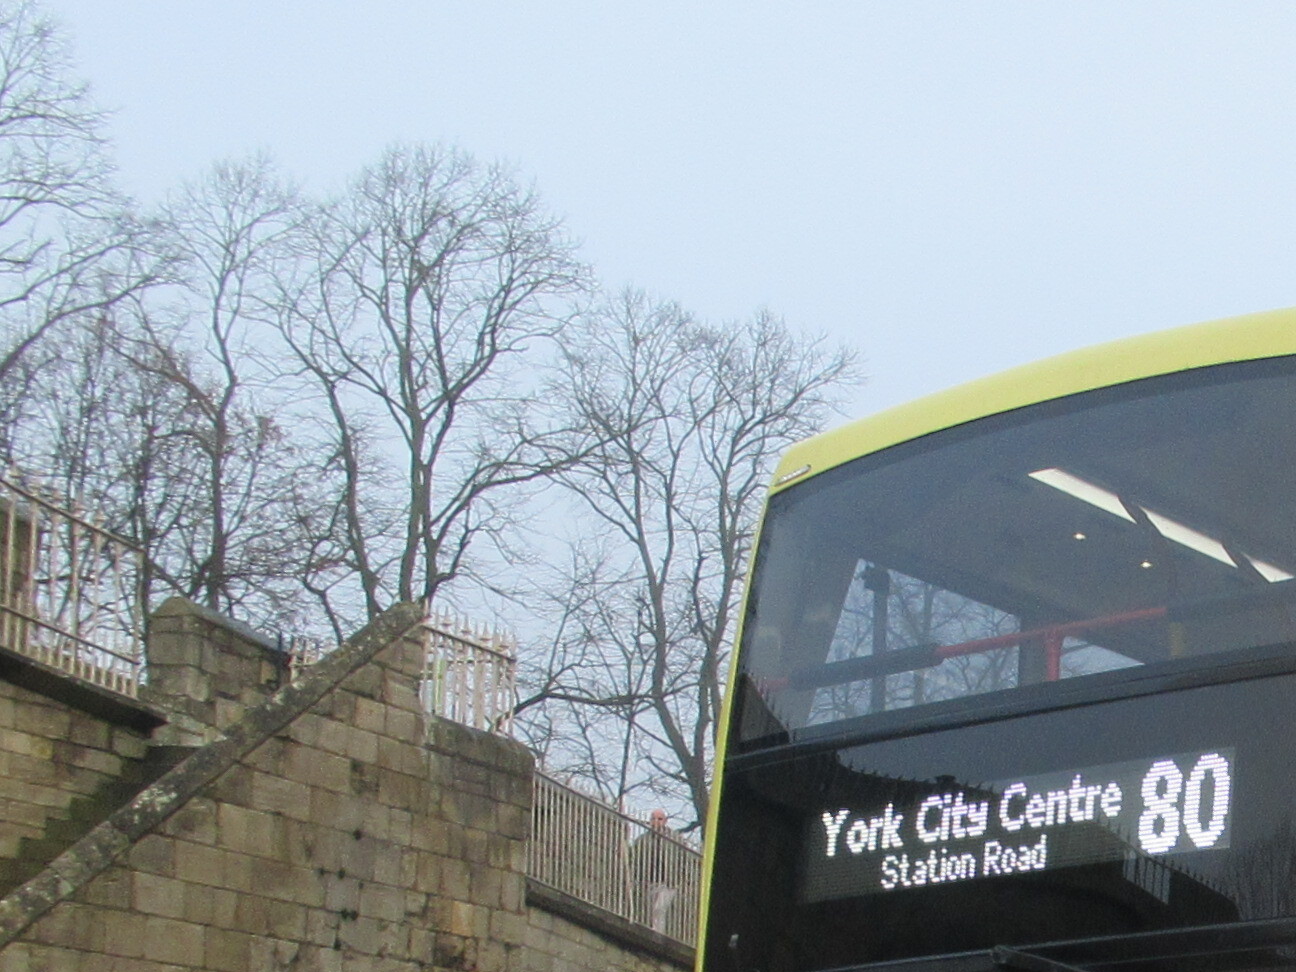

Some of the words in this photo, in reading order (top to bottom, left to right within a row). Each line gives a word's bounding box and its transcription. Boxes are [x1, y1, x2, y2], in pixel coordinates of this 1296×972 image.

[821, 801, 904, 857] York
[916, 792, 988, 843] City
[998, 774, 1123, 831] Centre
[1136, 752, 1232, 855] 80
[880, 849, 976, 890] Station
[983, 834, 1048, 876] Road
